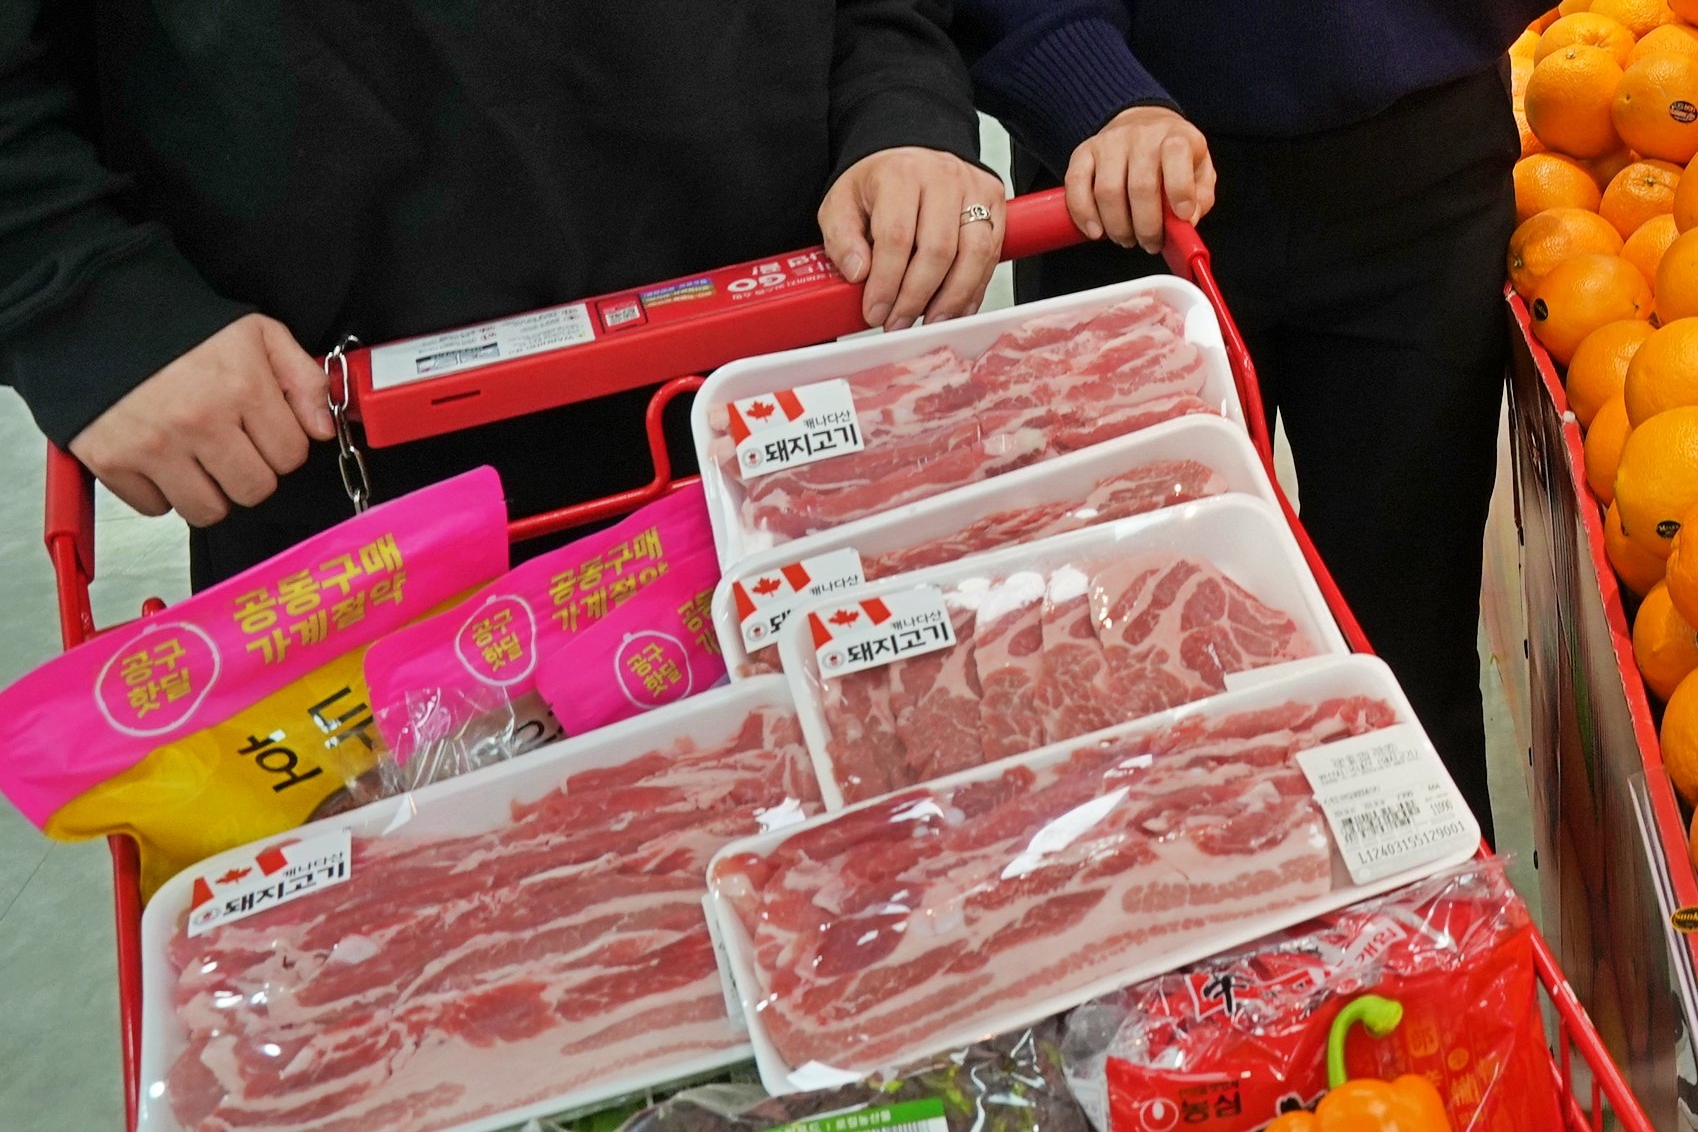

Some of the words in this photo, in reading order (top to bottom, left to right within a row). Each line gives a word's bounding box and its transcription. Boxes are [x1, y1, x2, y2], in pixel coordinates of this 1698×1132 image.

[803, 410, 851, 430] 캐나다산
[765, 423, 859, 463] 돼지고기
[232, 533, 405, 635] 공동구매
[550, 526, 664, 606] 공동구매
[809, 575, 858, 597] 캐나다산
[552, 562, 669, 633] 가계절약
[246, 572, 406, 665] 가계절약
[472, 609, 513, 648] 공구
[890, 610, 942, 631] 캐나다산
[121, 638, 186, 687] 공구
[482, 632, 523, 672] 핫딜
[627, 642, 664, 673] 공구
[847, 622, 949, 665] 돼지고기
[127, 667, 192, 719] 핫딜
[643, 660, 682, 698] 핫딜
[282, 852, 343, 877] 캐나다산
[222, 862, 345, 917] 돼지고기
